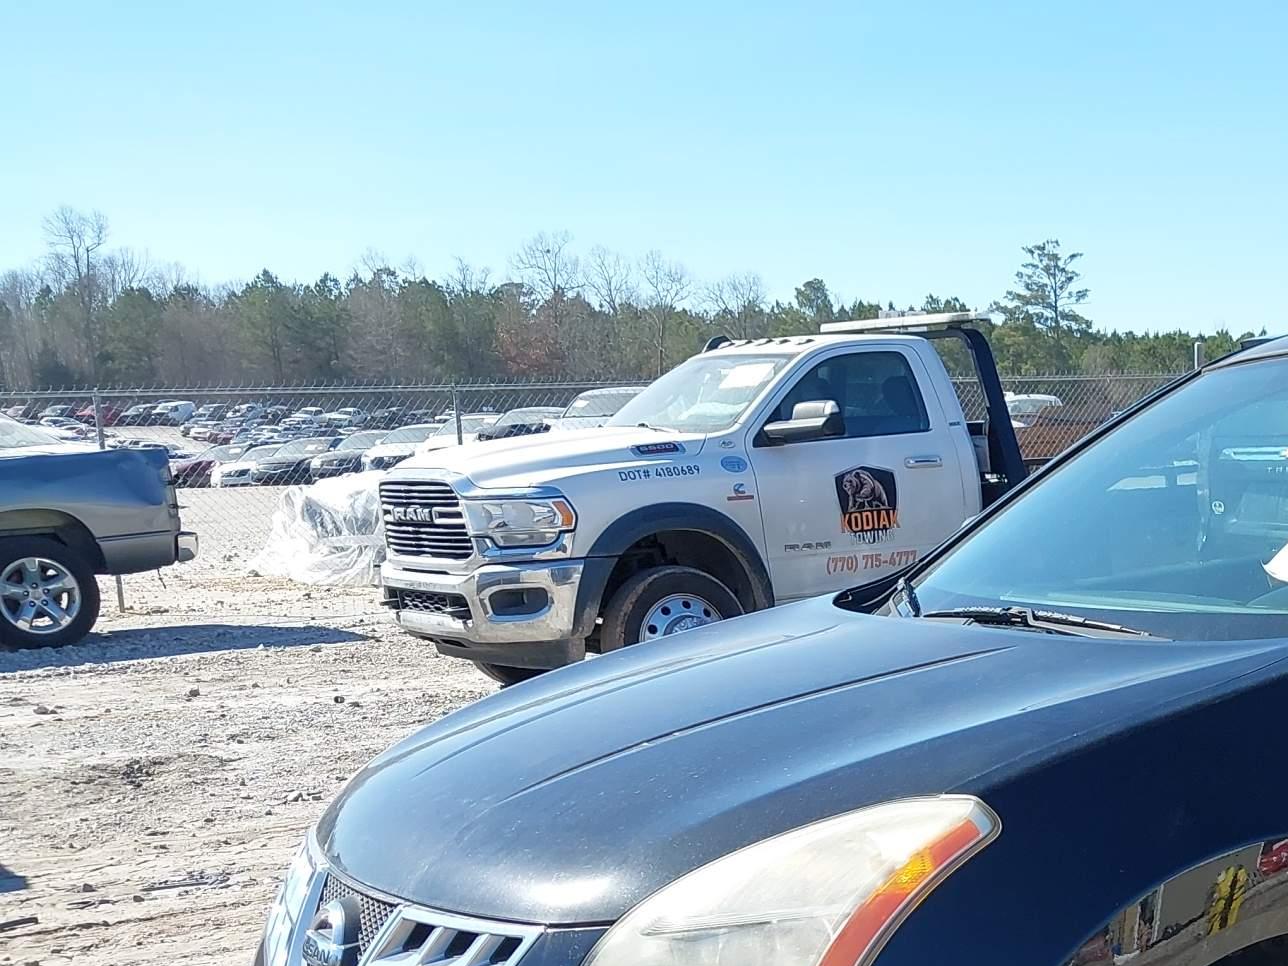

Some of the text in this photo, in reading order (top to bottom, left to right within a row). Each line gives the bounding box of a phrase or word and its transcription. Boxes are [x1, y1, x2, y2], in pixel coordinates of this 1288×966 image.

[618, 464, 700, 482] DOT# 4180689
[392, 506, 432, 521] RAM
[841, 509, 901, 534] KODIAK
[850, 529, 896, 545] TOWING
[826, 550, 917, 575] (770) 715-4777
